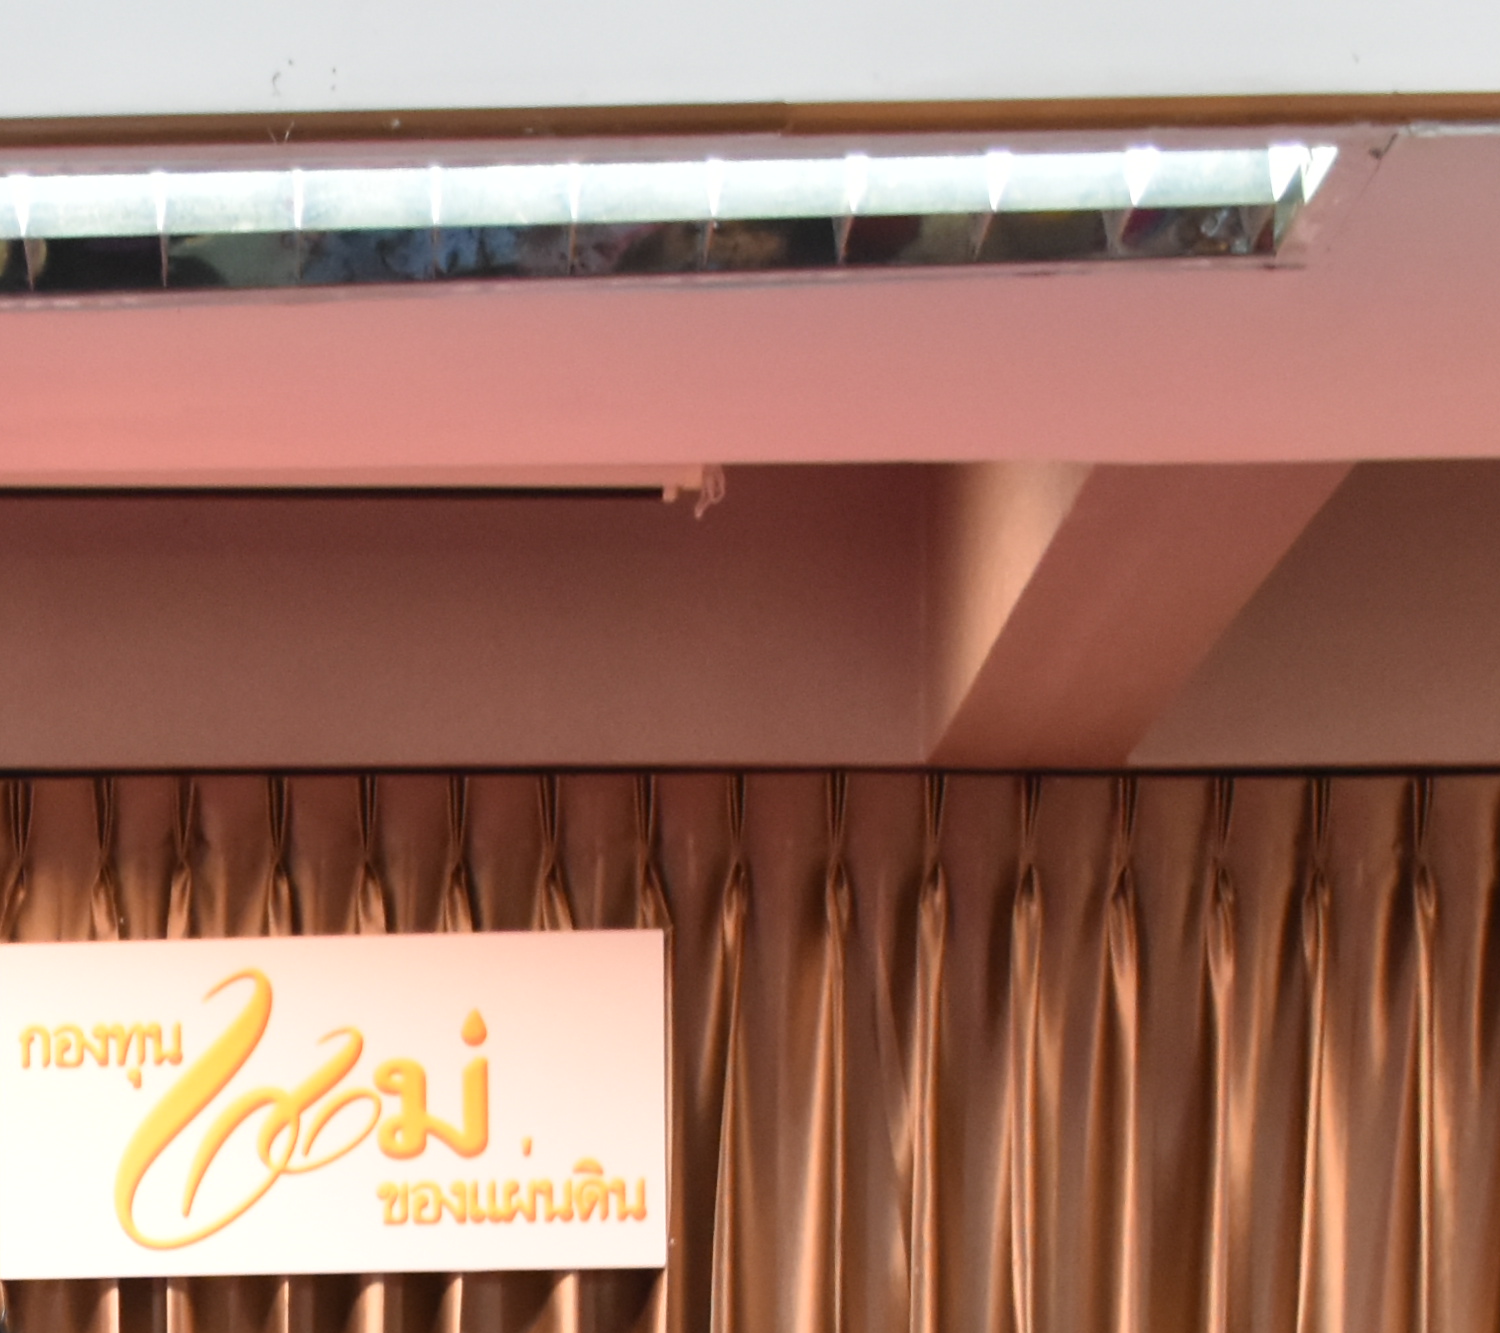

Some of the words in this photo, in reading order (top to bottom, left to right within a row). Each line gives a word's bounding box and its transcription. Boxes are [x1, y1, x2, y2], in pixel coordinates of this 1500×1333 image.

[19, 1022, 184, 1090] กองทุน
[376, 1137, 650, 1227] ของแผ่นดิน
